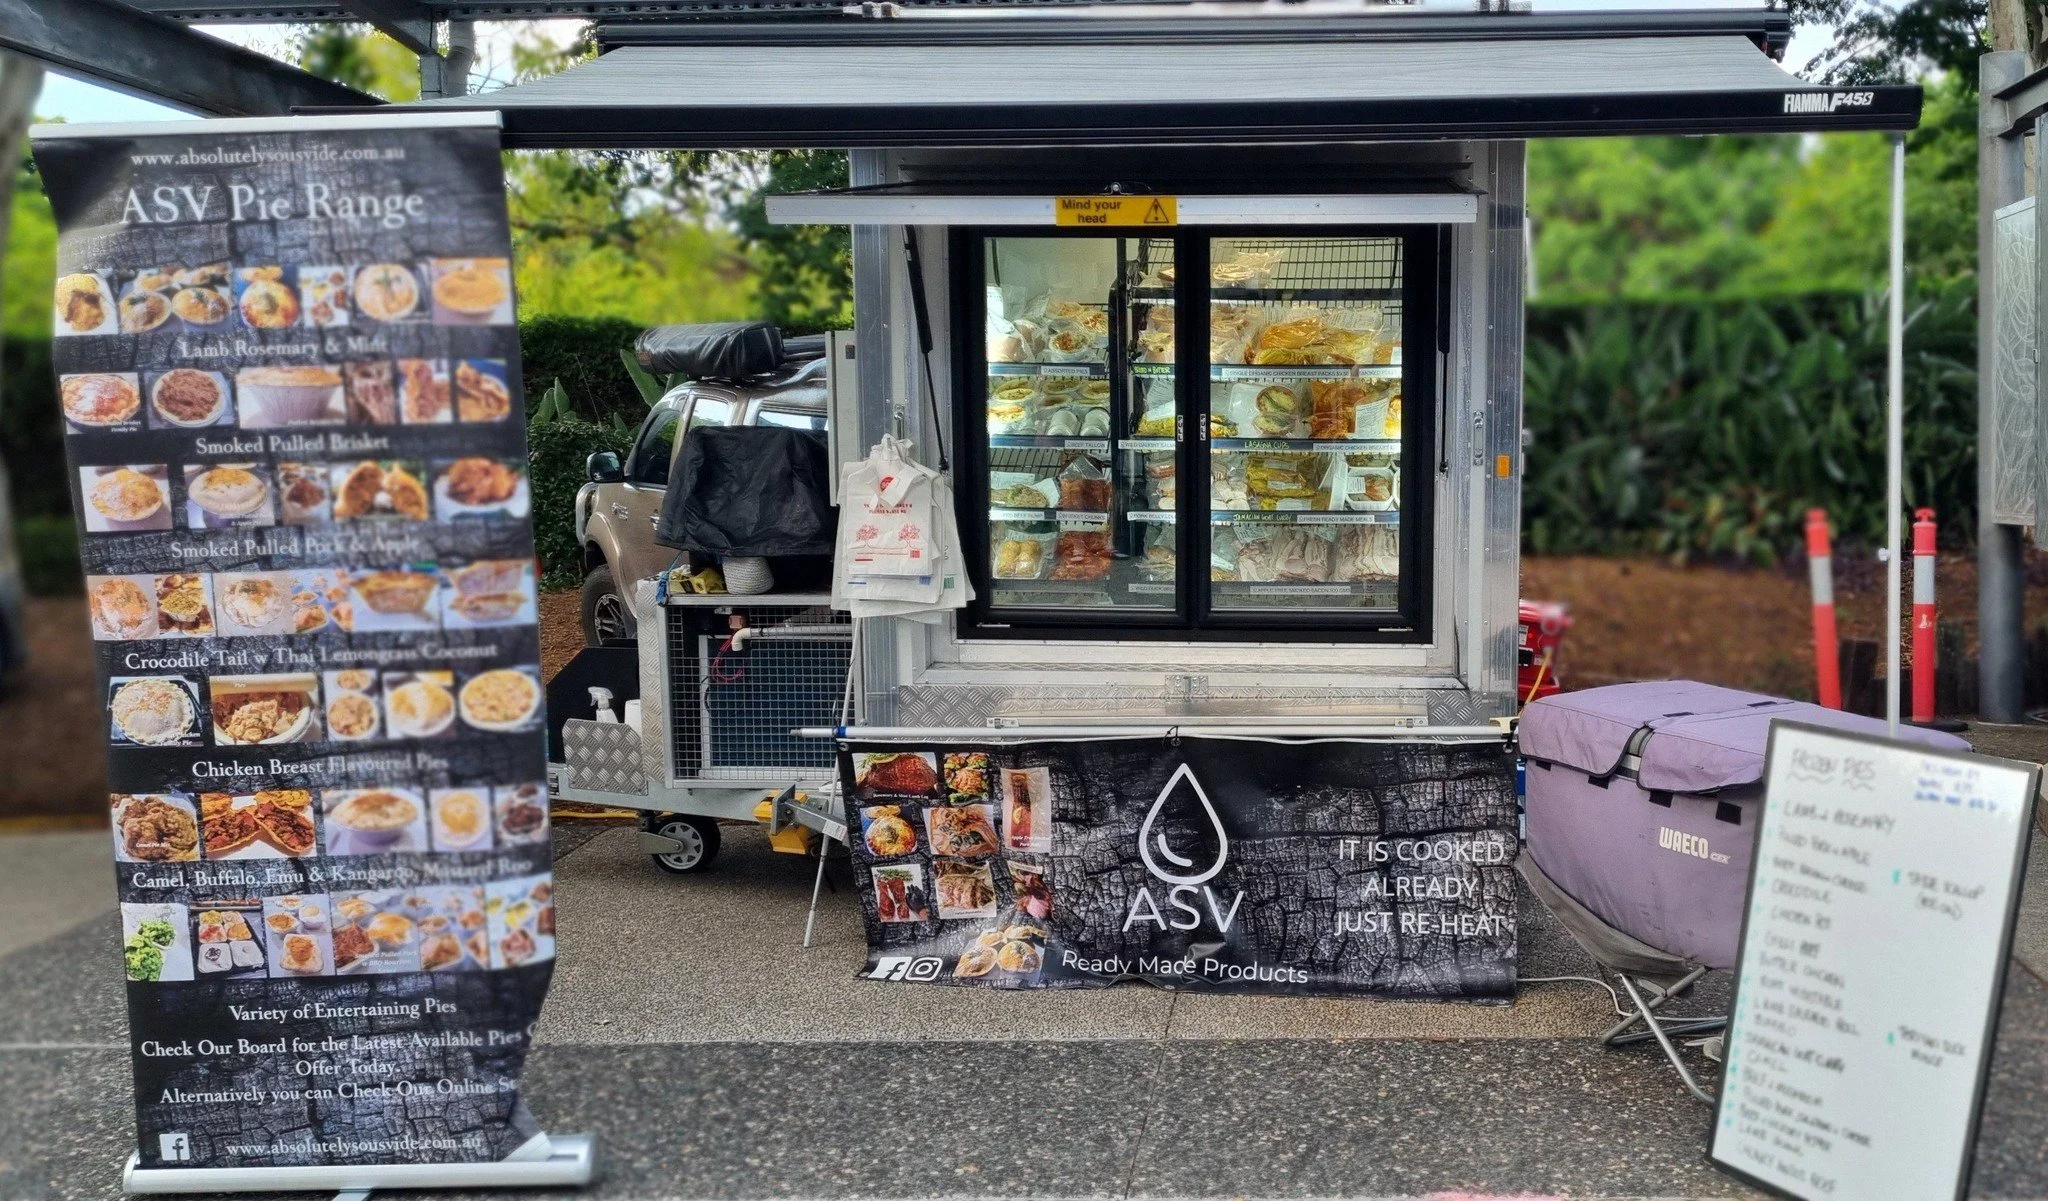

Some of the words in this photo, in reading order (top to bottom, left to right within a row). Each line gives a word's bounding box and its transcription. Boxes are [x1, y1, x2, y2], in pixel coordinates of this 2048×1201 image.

[1784, 93, 1829, 113] FIAMMA
[131, 145, 405, 166] www.absolutelysousvide.com.au
[119, 184, 215, 224] ASV
[228, 184, 292, 222] Pie
[304, 182, 424, 229] Range
[1062, 199, 1091, 210] Mind
[1095, 200, 1121, 211] your
[1077, 213, 1107, 223] head
[181, 340, 230, 358] Lamb
[235, 339, 320, 360] Rosemary
[325, 339, 341, 355] &
[346, 337, 389, 353] Mint
[196, 437, 265, 455] Smoked
[268, 434, 324, 453] Pulled
[330, 433, 389, 450] Brisket
[1245, 441, 1273, 450] LASAGNA
[171, 541, 240, 558] Smoked
[246, 539, 299, 556] Pulled
[306, 537, 347, 553] Pork
[125, 653, 209, 670] Crocodile
[214, 650, 248, 667] Tail
[252, 654, 267, 666] w
[273, 648, 315, 665] Thai
[319, 645, 417, 666] Lemongrass
[421, 643, 498, 659] Coconut
[192, 760, 263, 778] Chicken
[269, 758, 322, 775] Breast
[328, 754, 412, 772] Flavoured
[415, 753, 448, 769] Pies
[1339, 839, 1360, 860] IT
[1368, 841, 1389, 862] IS
[1396, 841, 1504, 862] COOKED
[1659, 827, 1708, 859] WAECO
[133, 871, 191, 891] Camel,
[195, 869, 261, 889] Buffalo,
[265, 867, 304, 885] Emu
[309, 867, 325, 883] &
[1364, 877, 1477, 898] ALREADY
[1122, 884, 1244, 933] ASV
[1334, 911, 1393, 936] JUST
[1401, 912, 1505, 936] RE-HEAT
[1062, 950, 1131, 974] Ready
[1139, 956, 1196, 975] Made
[1204, 958, 1308, 984] Products
[229, 1004, 288, 1022] Variety
[293, 1002, 312, 1019] of
[314, 1001, 420, 1018] Entertaining
[425, 998, 457, 1014] Pies
[141, 1041, 193, 1057] Check
[198, 1039, 233, 1056] Our
[238, 1038, 287, 1054] Board
[292, 1037, 316, 1053] for
[321, 1036, 348, 1052] the
[353, 1035, 402, 1051] Latest
[410, 1031, 484, 1048] Available
[488, 1030, 522, 1046] Pies
[296, 1059, 342, 1077] Offer
[349, 1058, 400, 1078] Today.
[159, 1088, 266, 1107] Alternatively
[271, 1089, 300, 1103] you
[305, 1087, 333, 1100] can
[338, 1083, 392, 1099] Check
[397, 1080, 433, 1097] Our
[436, 1078, 493, 1095] Online
[226, 1136, 481, 1157] www.absolutelysousvide.com.au
